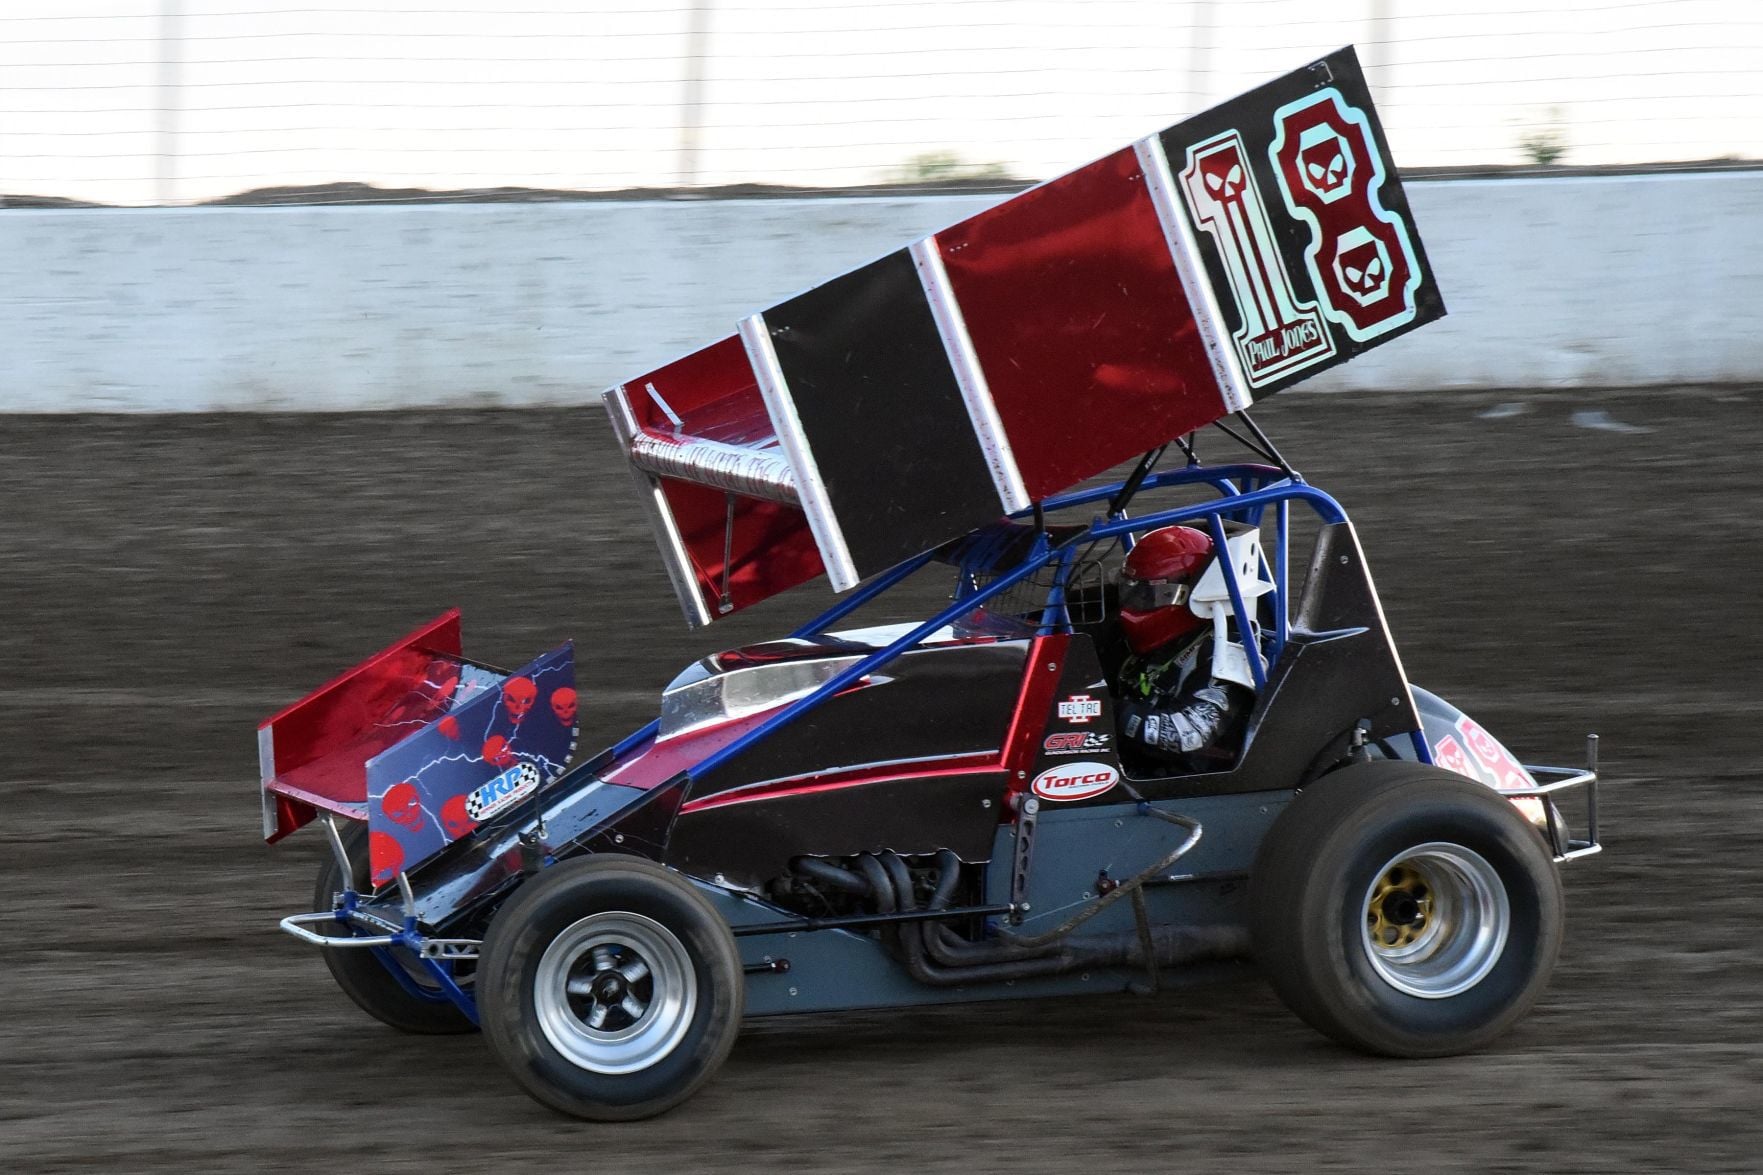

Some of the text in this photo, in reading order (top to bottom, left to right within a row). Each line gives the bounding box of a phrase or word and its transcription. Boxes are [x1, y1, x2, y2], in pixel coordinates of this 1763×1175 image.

[1179, 87, 1423, 389] 18
[1280, 320, 1319, 357] JONES
[1060, 701, 1100, 716] TEL TAC
[1044, 732, 1089, 750] GRI
[480, 767, 522, 808] HRP
[1043, 772, 1112, 790] Torco
